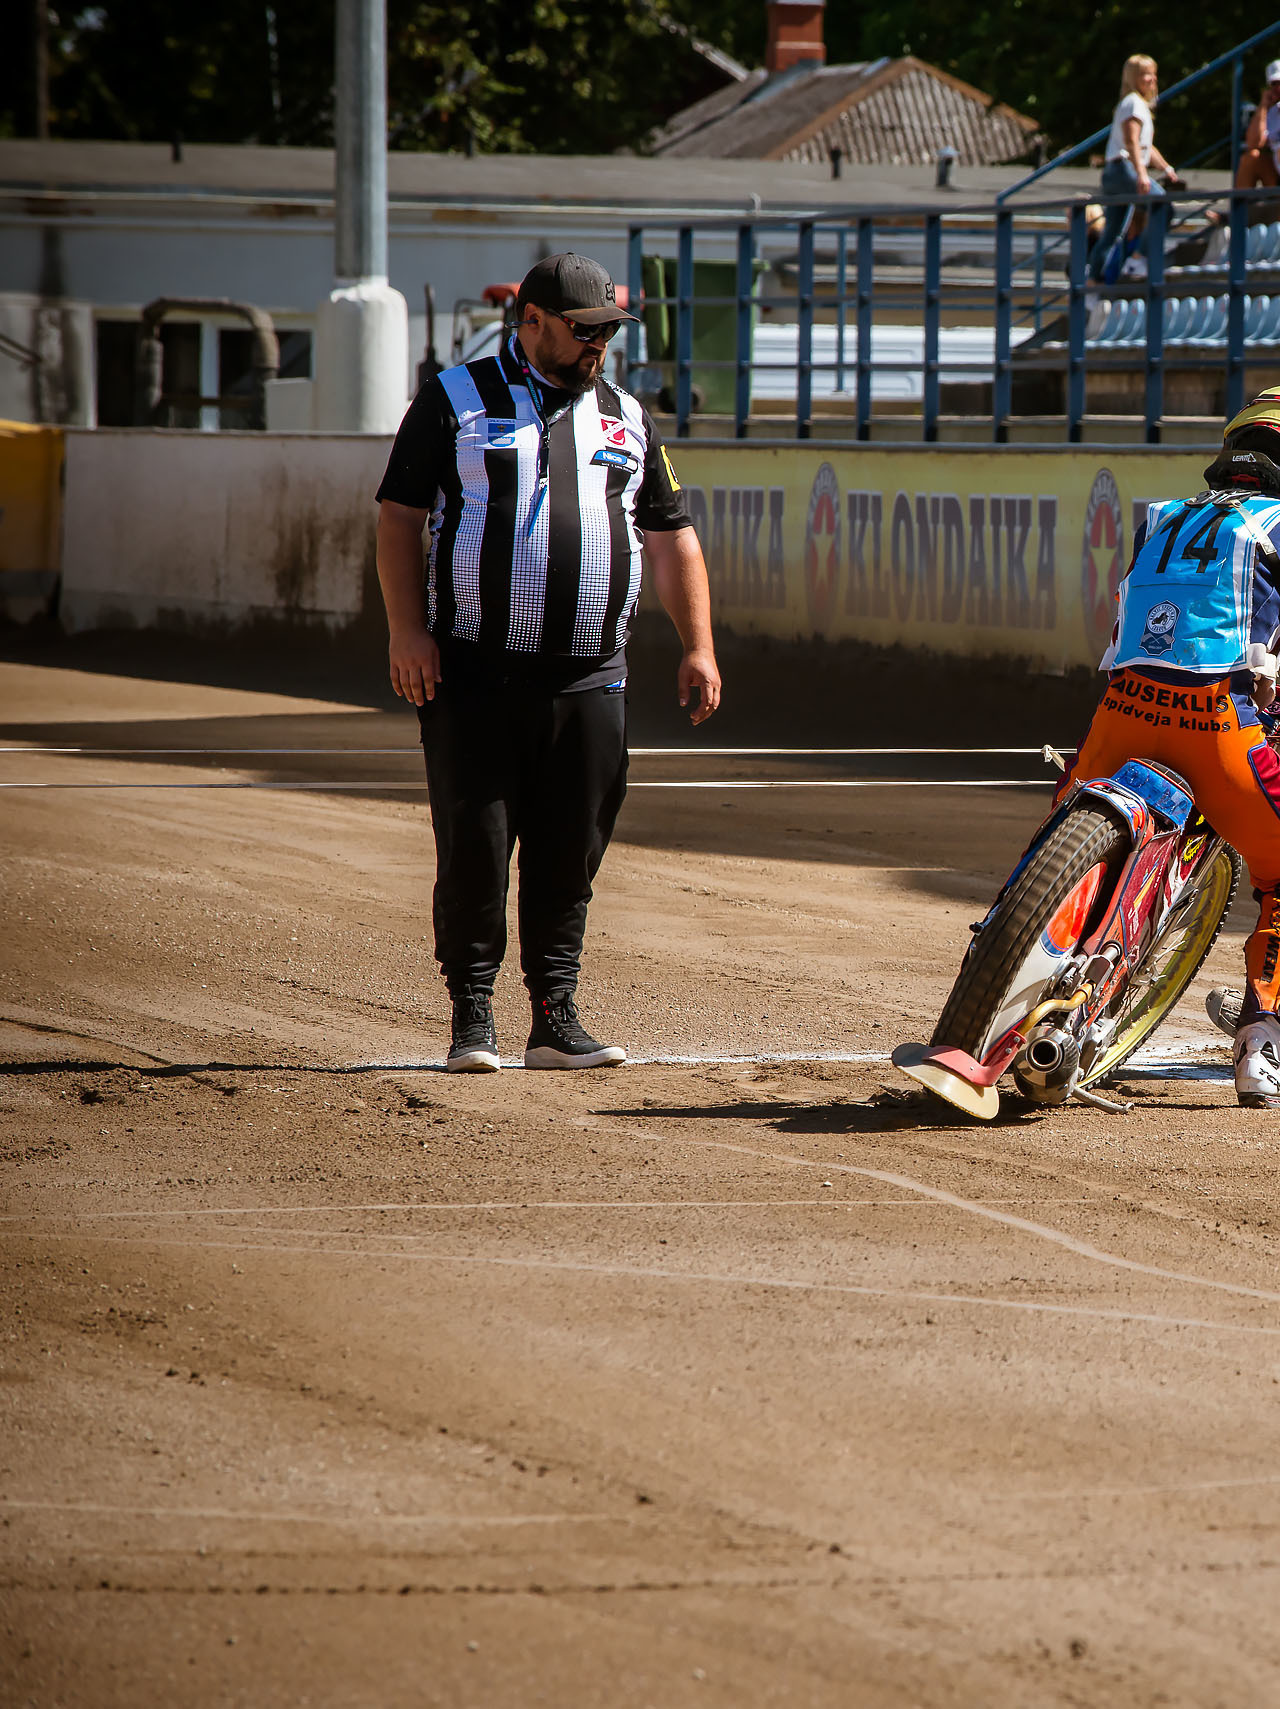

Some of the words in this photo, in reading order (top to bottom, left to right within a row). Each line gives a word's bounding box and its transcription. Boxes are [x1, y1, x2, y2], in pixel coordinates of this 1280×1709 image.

[603, 452, 622, 463] Nice
[1156, 509, 1229, 574] 14
[844, 489, 1058, 631] KLONDAIKA
[1103, 696, 1171, 727] spīdveja
[1179, 716, 1231, 732] klubs
[1110, 678, 1229, 714] AUSEKLIS
